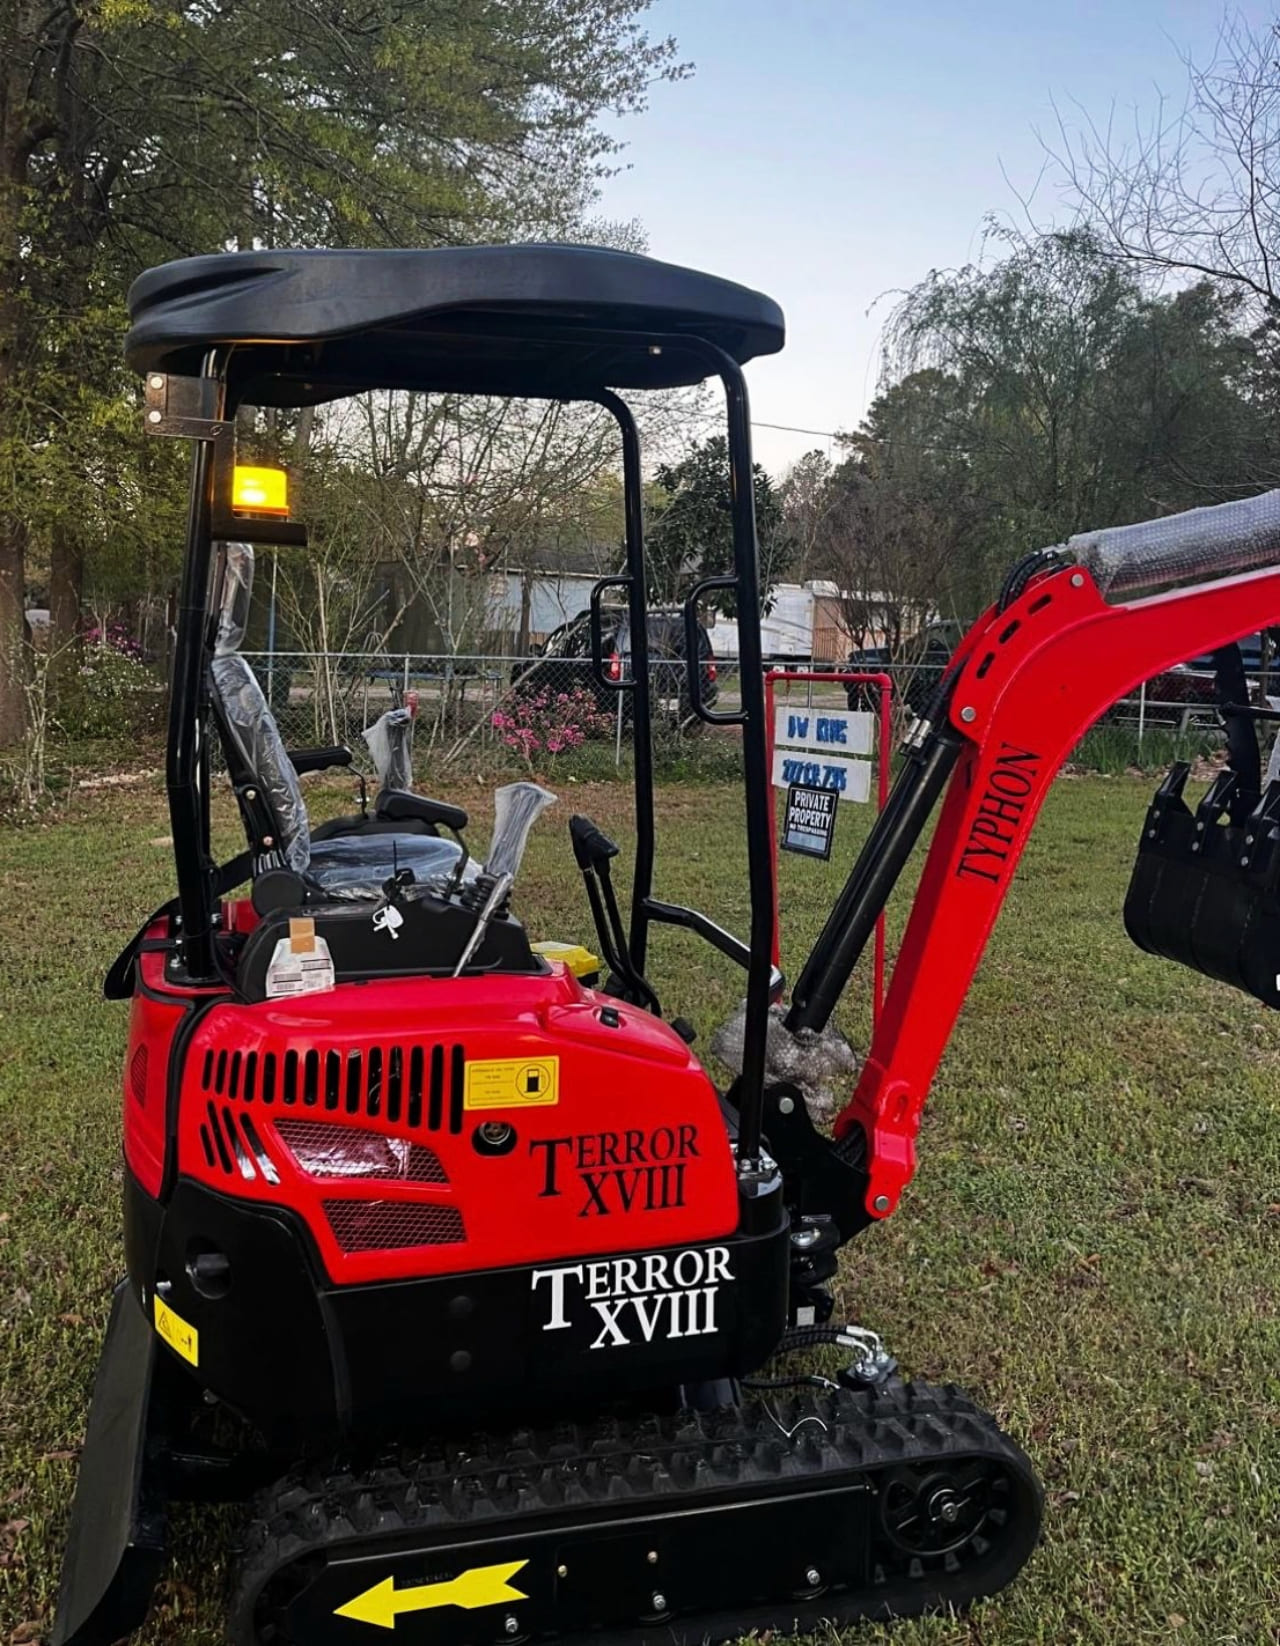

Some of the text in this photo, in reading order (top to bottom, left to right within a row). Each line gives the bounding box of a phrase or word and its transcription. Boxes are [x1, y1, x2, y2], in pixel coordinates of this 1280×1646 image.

[788, 806, 832, 828] PROPERTY
[794, 790, 831, 811] PRIVATE
[956, 742, 1042, 884] TYPHON
[529, 1124, 700, 1197] TERROR
[578, 1164, 687, 1217] XVIII
[531, 1246, 736, 1331] TERROR
[589, 1287, 719, 1350] XVIII
